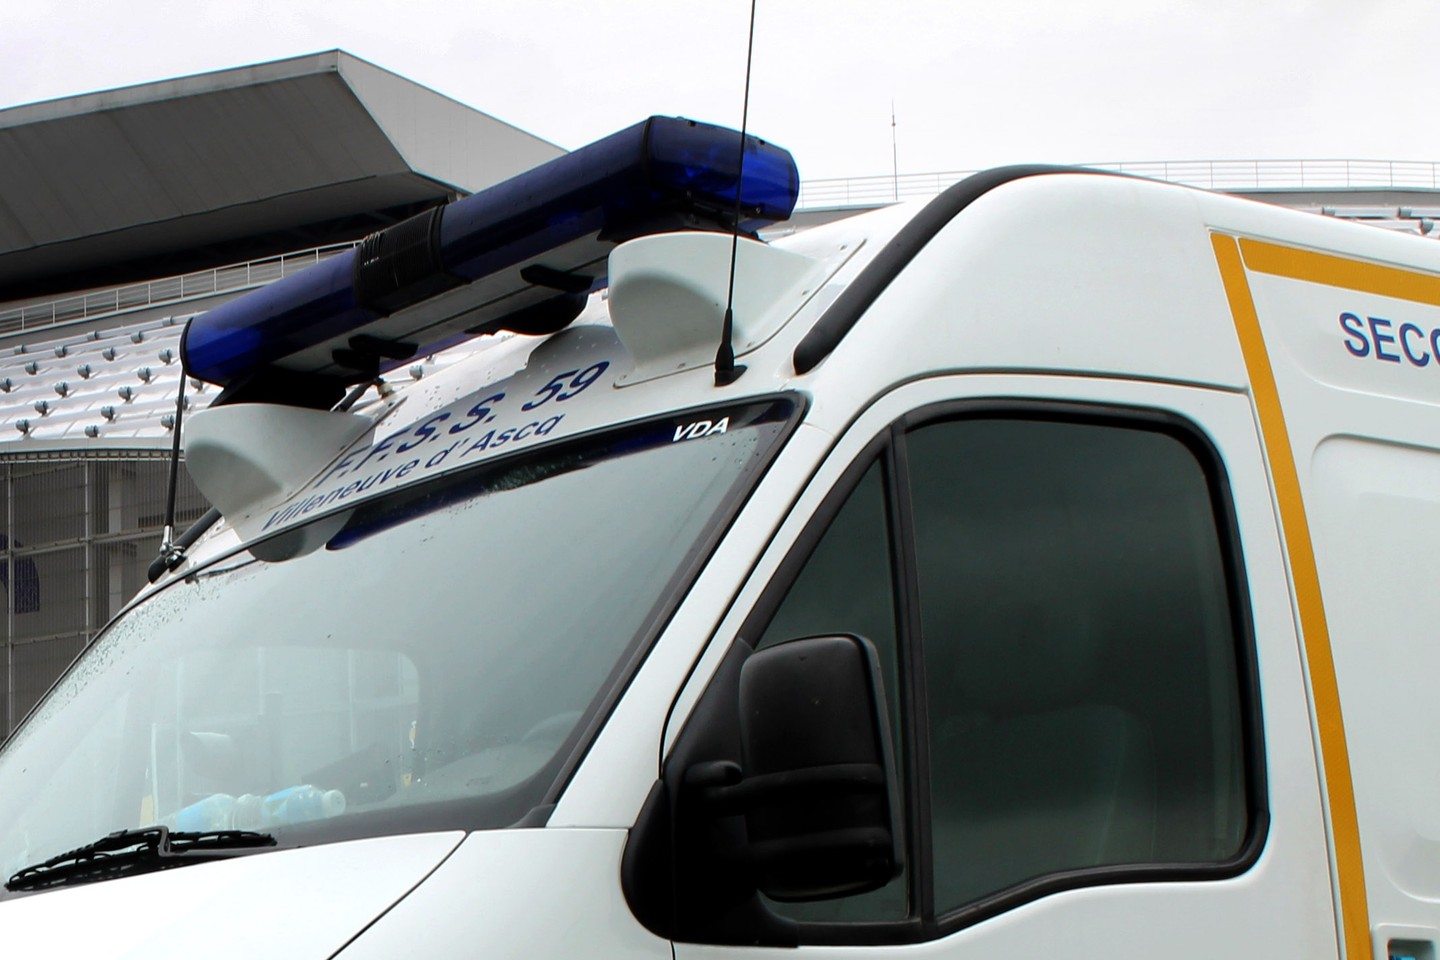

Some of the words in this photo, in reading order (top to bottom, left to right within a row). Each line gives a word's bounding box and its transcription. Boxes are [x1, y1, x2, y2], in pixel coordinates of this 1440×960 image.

[521, 360, 610, 412] 59
[672, 416, 730, 442] VDA
[261, 458, 420, 531] Villeneuve
[424, 413, 566, 469] d'Ascq
